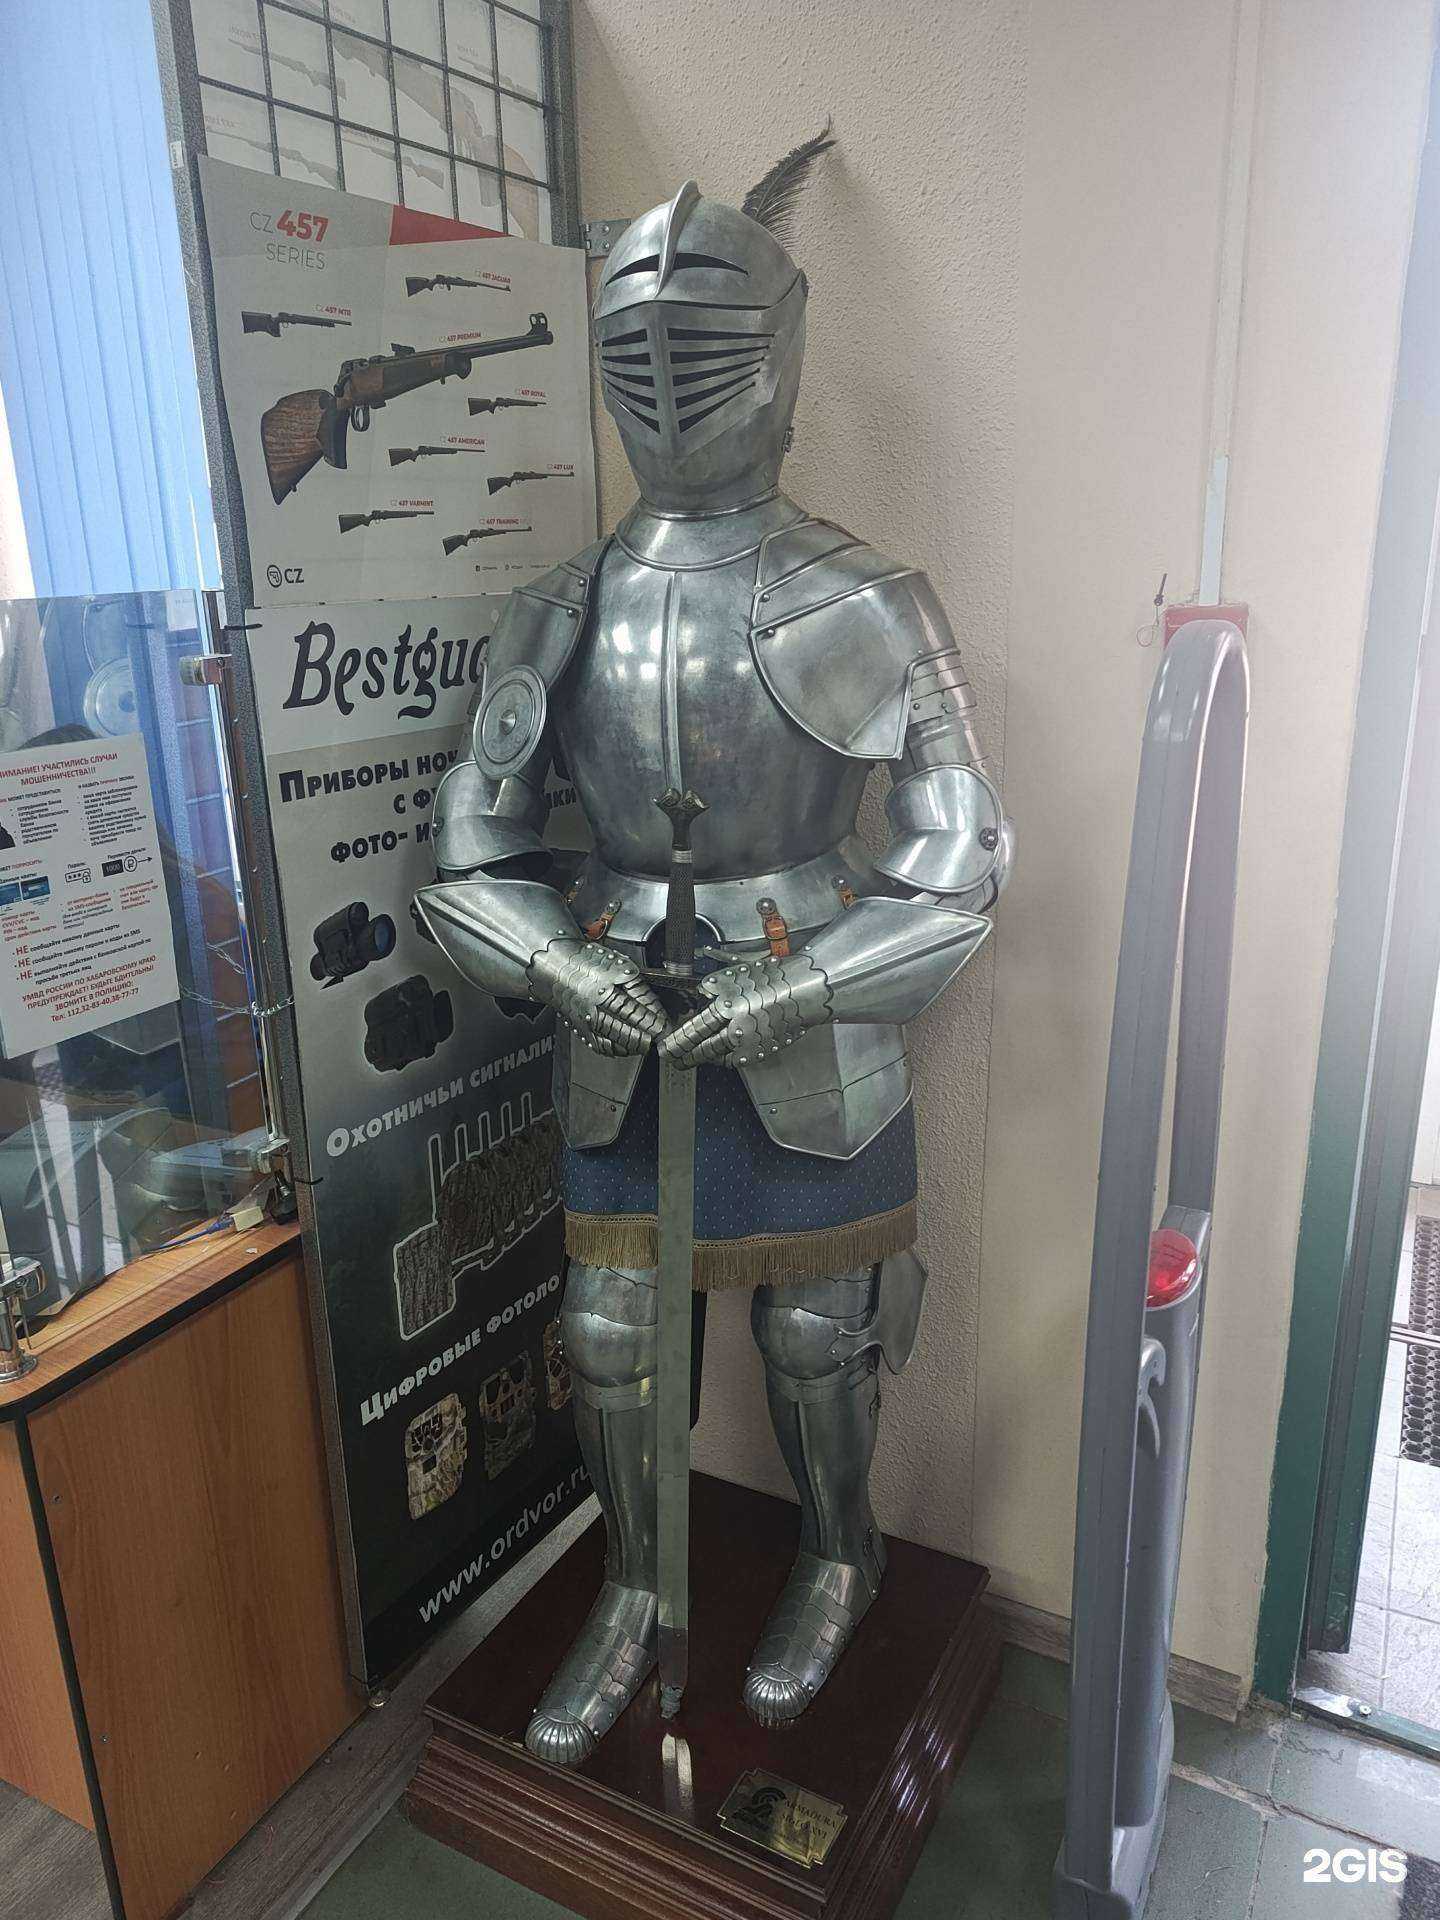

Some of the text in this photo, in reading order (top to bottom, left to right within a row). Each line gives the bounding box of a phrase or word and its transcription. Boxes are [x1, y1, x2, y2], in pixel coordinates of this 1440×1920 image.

[250, 210, 329, 242] CZ 457
[265, 242, 326, 270] SERIES
[285, 568, 305, 583] CZ
[41, 757, 89, 772] УЧАСТИЛИСЬ
[330, 830, 408, 863] ФОТО-
[16, 945, 29, 956] НЕ
[18, 957, 31, 968] НЕ
[20, 969, 33, 980] НЕ
[45, 982, 74, 994] РОССИИ
[469, 1035, 555, 1088] СИГНАЛИ
